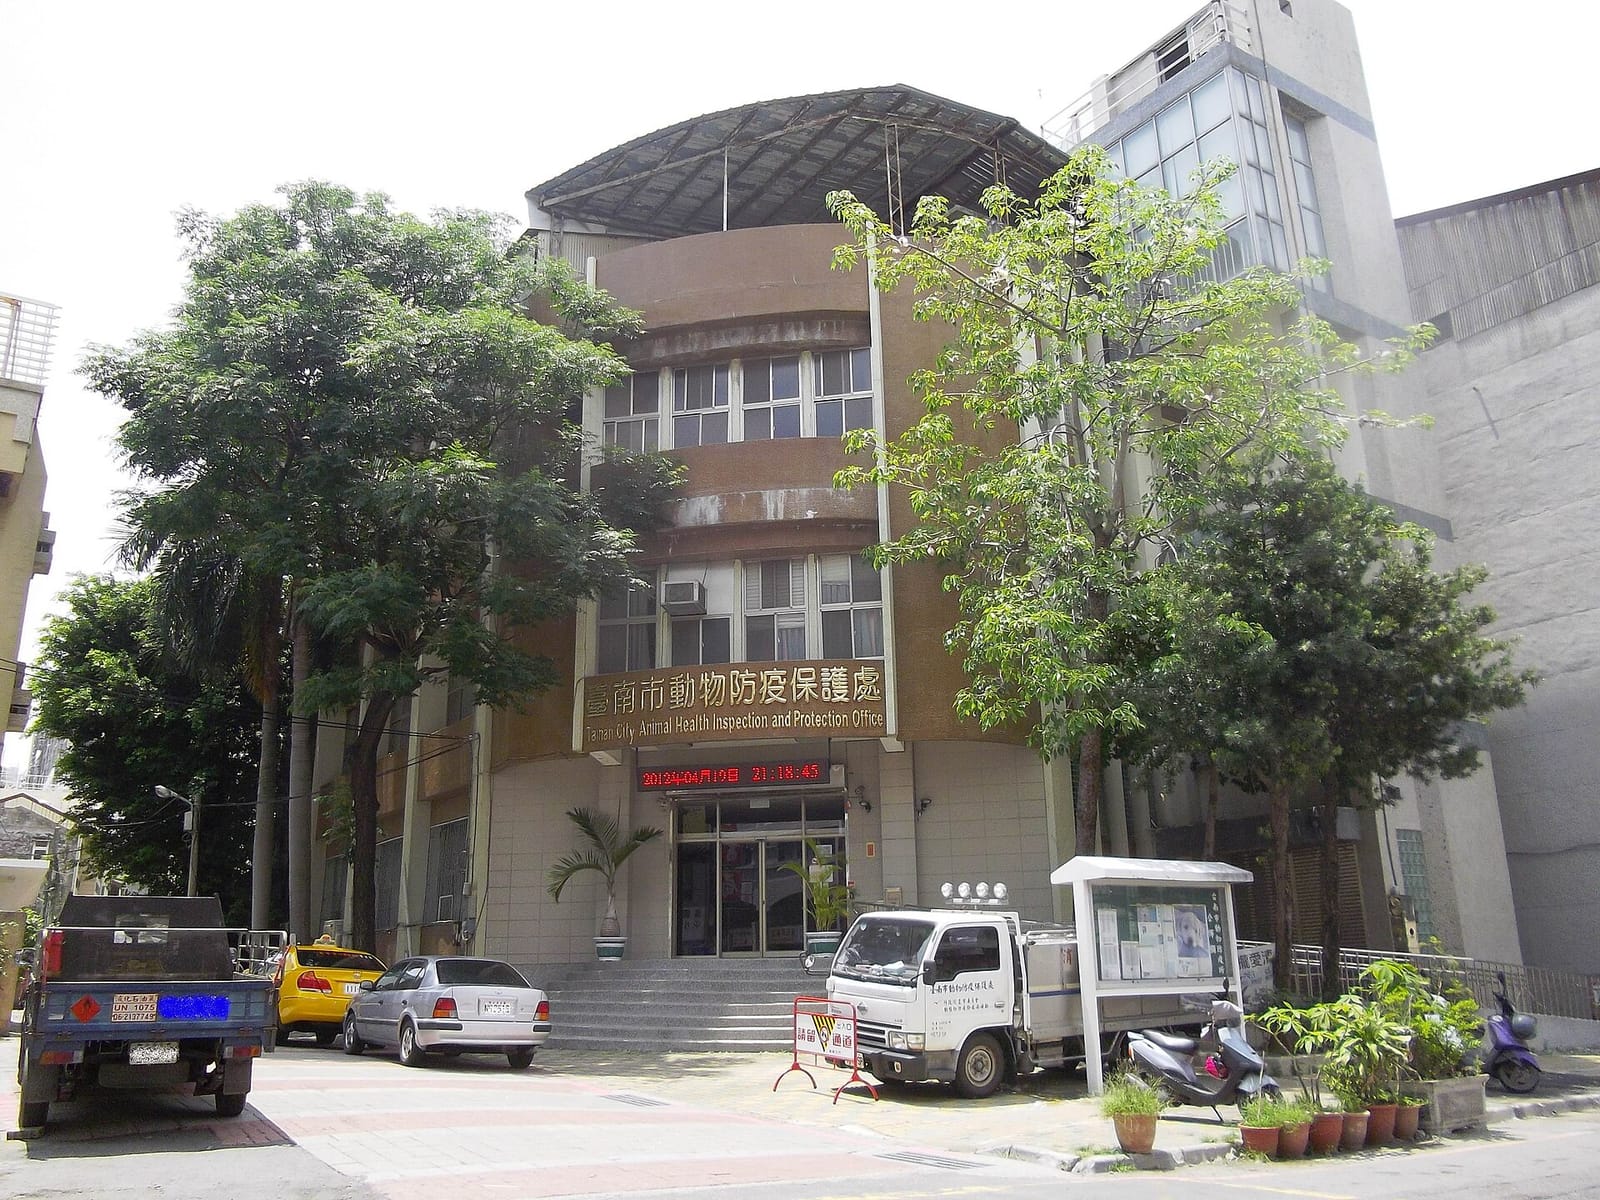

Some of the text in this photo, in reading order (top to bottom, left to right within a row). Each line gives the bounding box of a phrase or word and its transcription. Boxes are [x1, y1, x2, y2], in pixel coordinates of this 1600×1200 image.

[587, 665, 882, 718] 臺南市動物防疫保護處
[586, 708, 884, 744] Tainan City Animal Health Inspection and Protection Office
[751, 764, 820, 783] 21:18:45
